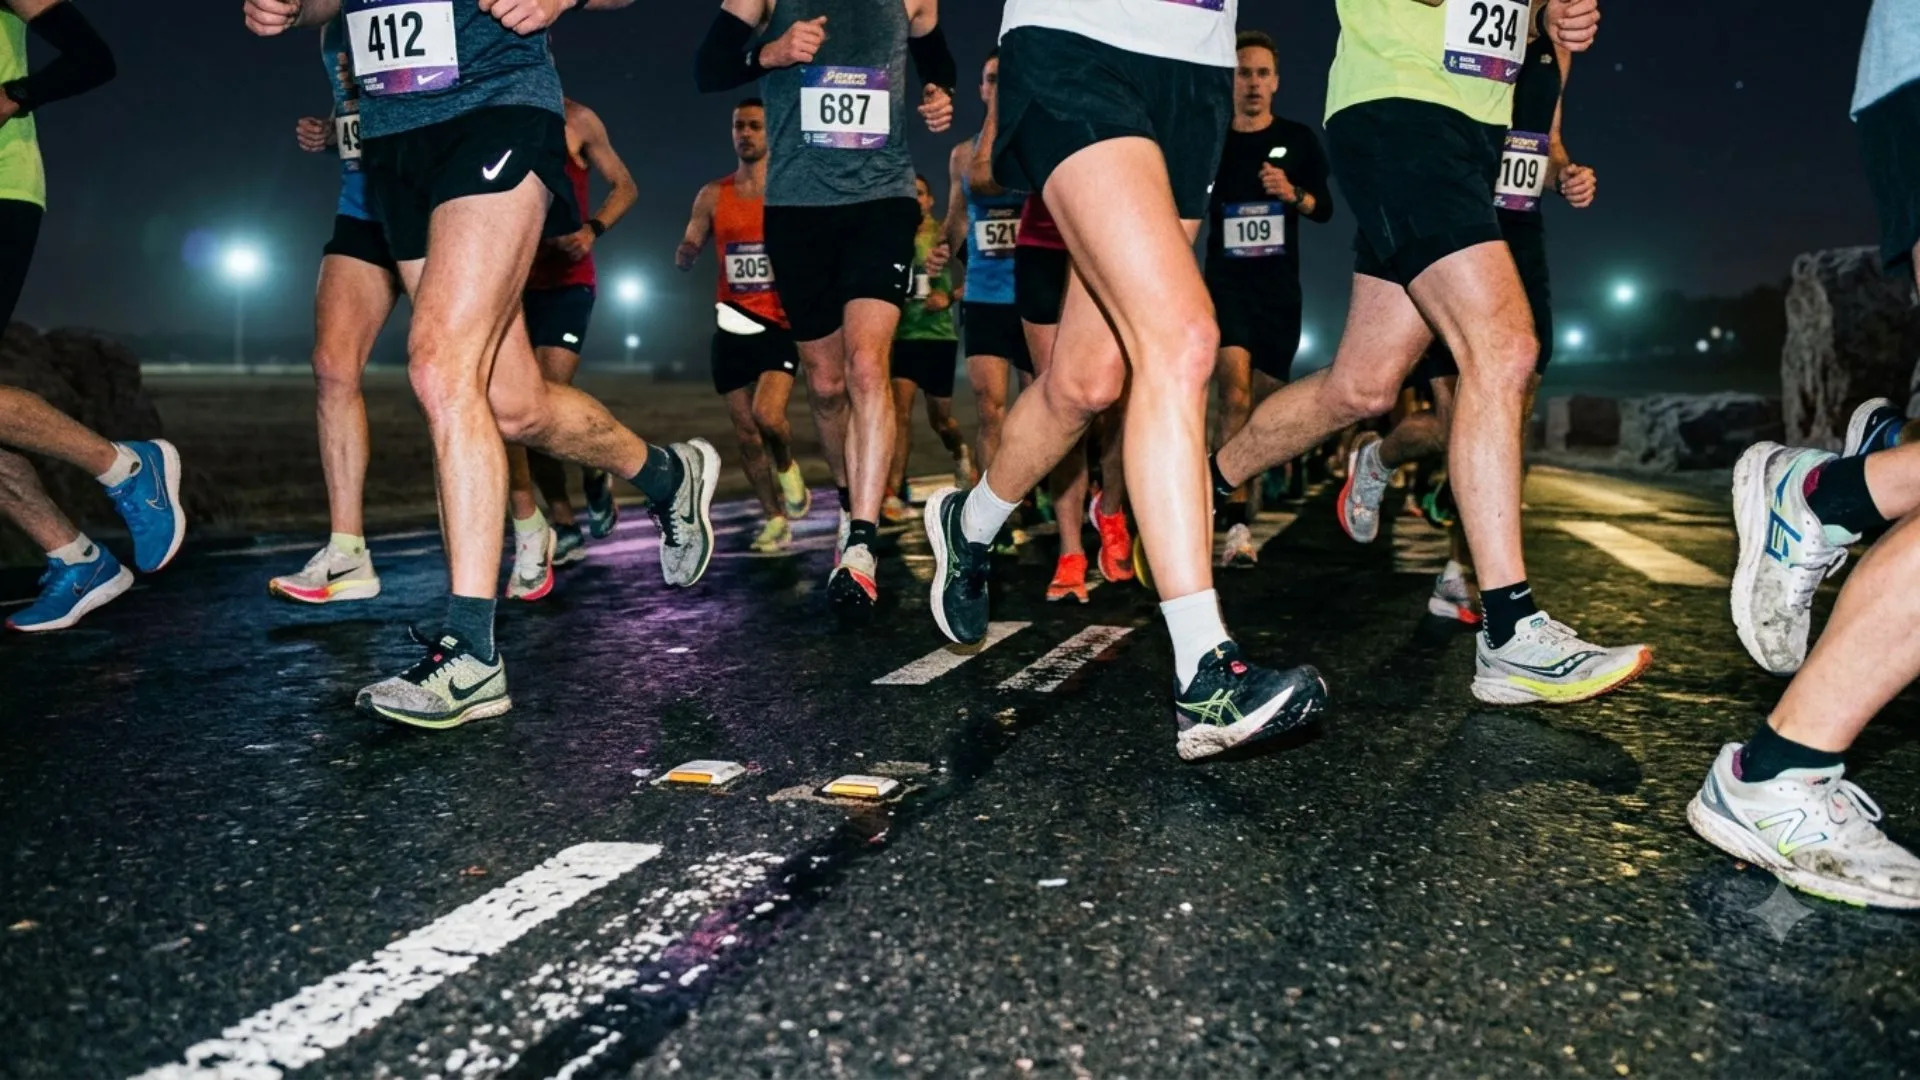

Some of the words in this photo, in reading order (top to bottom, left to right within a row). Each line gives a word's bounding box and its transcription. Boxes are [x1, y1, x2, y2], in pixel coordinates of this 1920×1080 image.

[368, 11, 426, 60] 412
[1468, 1, 1518, 50] 234
[820, 93, 871, 125] 687
[1502, 158, 1539, 188] 109
[985, 223, 1017, 245] 521
[1237, 220, 1271, 242] 109
